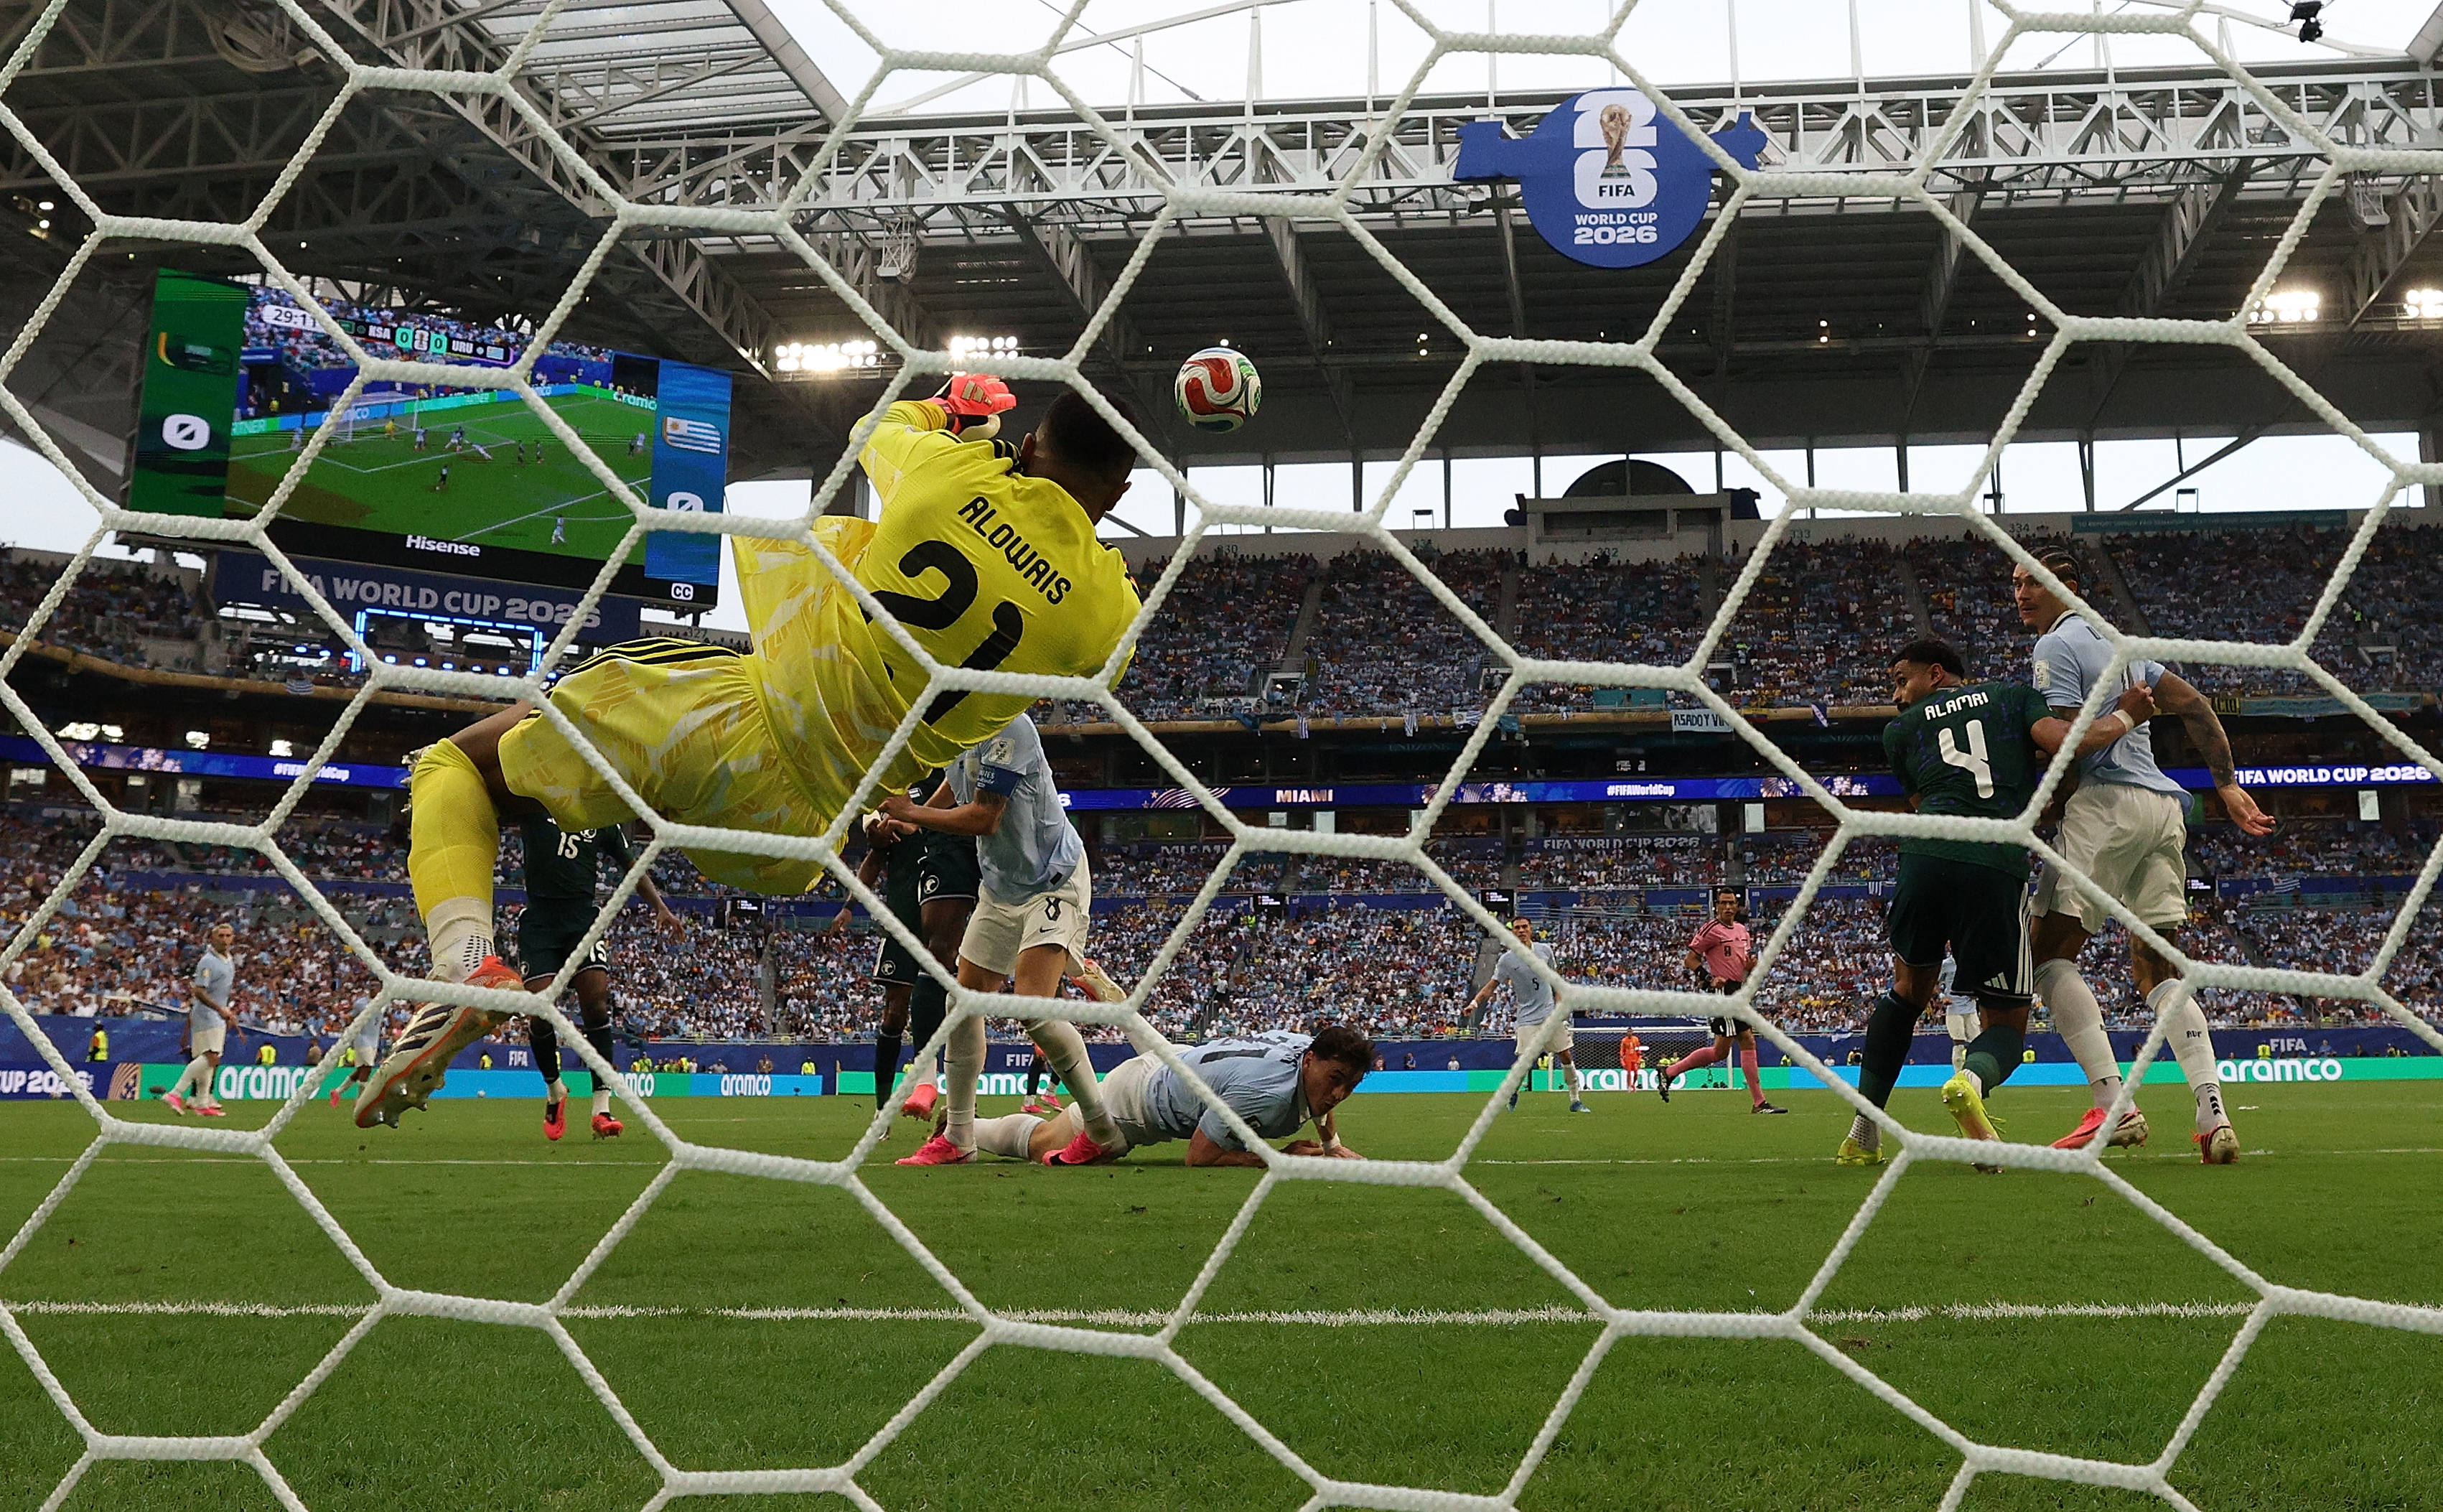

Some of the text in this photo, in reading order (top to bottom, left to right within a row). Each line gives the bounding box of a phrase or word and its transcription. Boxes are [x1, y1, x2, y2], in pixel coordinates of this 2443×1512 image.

[1598, 185, 1635, 197] FIFA
[1574, 213, 1658, 225] WORLD CUP
[1574, 226, 1658, 245] 2026
[273, 309, 316, 328] 29:11
[401, 331, 408, 343] 0
[434, 337, 442, 350] 0
[452, 340, 474, 354] URU
[406, 534, 480, 556] Hisense
[958, 496, 1071, 605] ALOWAIS
[333, 577, 439, 609] WORLD
[444, 591, 500, 616] CUP
[673, 584, 691, 599] CC
[1925, 692, 1989, 720] ALAMRI
[1938, 719, 1994, 799] 4
[2266, 768, 2330, 784] WORLD
[2332, 767, 2368, 783] CUP
[2370, 766, 2432, 782] 2026
[1276, 789, 1333, 803] MIAMI
[1607, 784, 1675, 797] #FIFAWorldCup
[557, 831, 581, 859] 15
[1543, 838, 1572, 849] FIFA
[1532, 977, 1540, 991] 5
[2270, 1038, 2308, 1053] FIFA
[508, 1050, 528, 1067] FIFA
[2218, 1058, 2342, 1083] aramco
[721, 1074, 771, 1096] aramco
